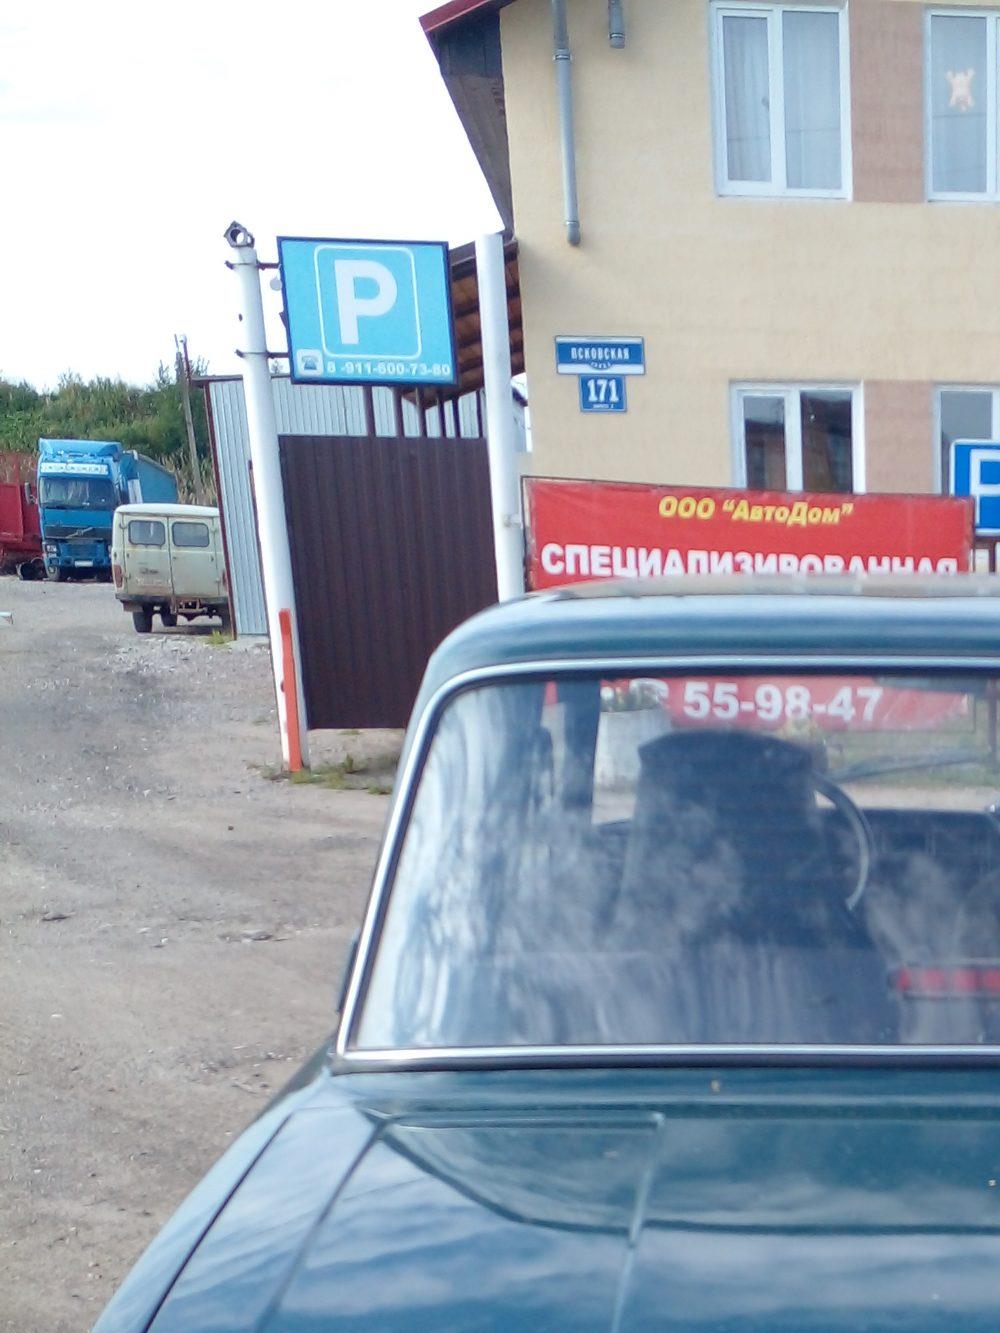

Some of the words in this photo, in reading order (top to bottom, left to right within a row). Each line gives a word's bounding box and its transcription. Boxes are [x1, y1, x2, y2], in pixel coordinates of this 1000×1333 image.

[334, 259, 398, 346] P
[570, 346, 630, 360] ПСКОВСКАЯ
[586, 378, 620, 403] 171
[659, 495, 716, 520] ООО
[683, 681, 884, 722] 55-98-47
